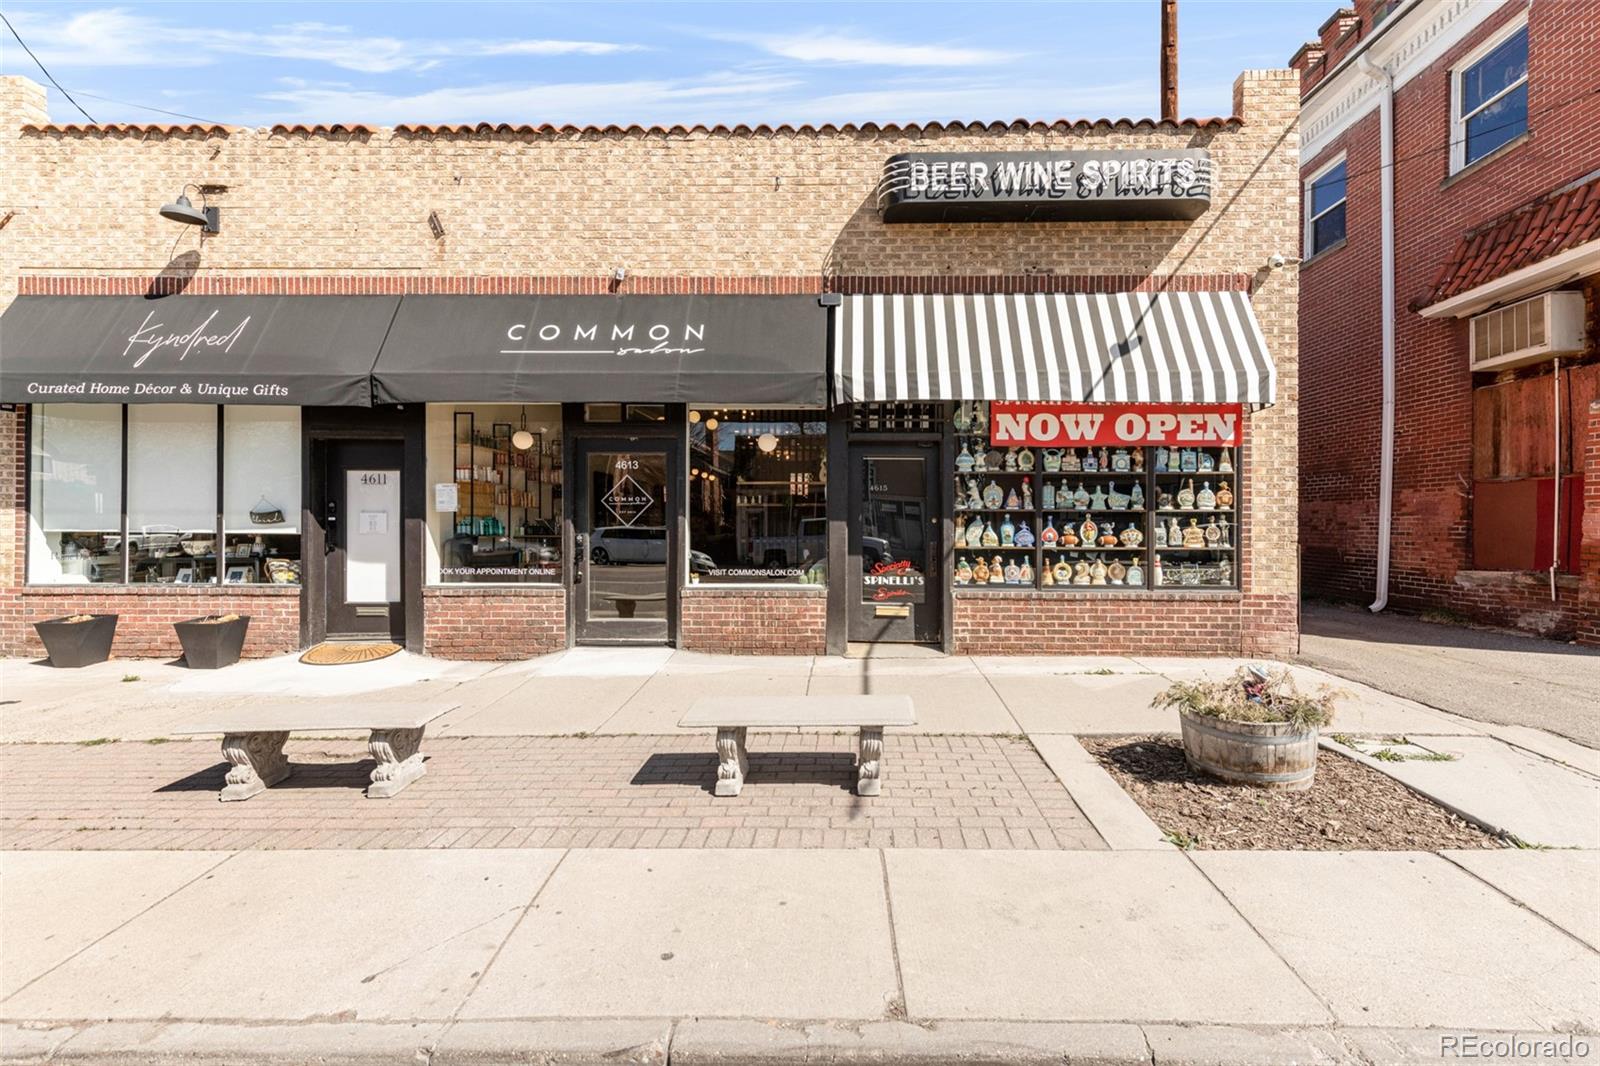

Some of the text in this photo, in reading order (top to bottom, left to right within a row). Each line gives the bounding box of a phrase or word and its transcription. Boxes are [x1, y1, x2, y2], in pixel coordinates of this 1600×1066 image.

[910, 157, 1196, 191] BEER WINE SPIRITS
[123, 310, 251, 368] Kyndred
[507, 324, 705, 341] COMMON
[616, 341, 705, 356] salon
[27, 382, 288, 398] Curated Home Décor & Unique Gifts
[995, 413, 1237, 441] NOW OPEN
[615, 460, 639, 470] 4613
[361, 473, 387, 486] 4611
[870, 484, 888, 492] 4615
[454, 567, 476, 576] YOUR
[476, 567, 527, 576] APPOINTMENT
[528, 567, 556, 576] ONLINE
[708, 568, 805, 576] VISIT COMMONSALON.COM
[863, 576, 925, 585] SPINELLI'S
